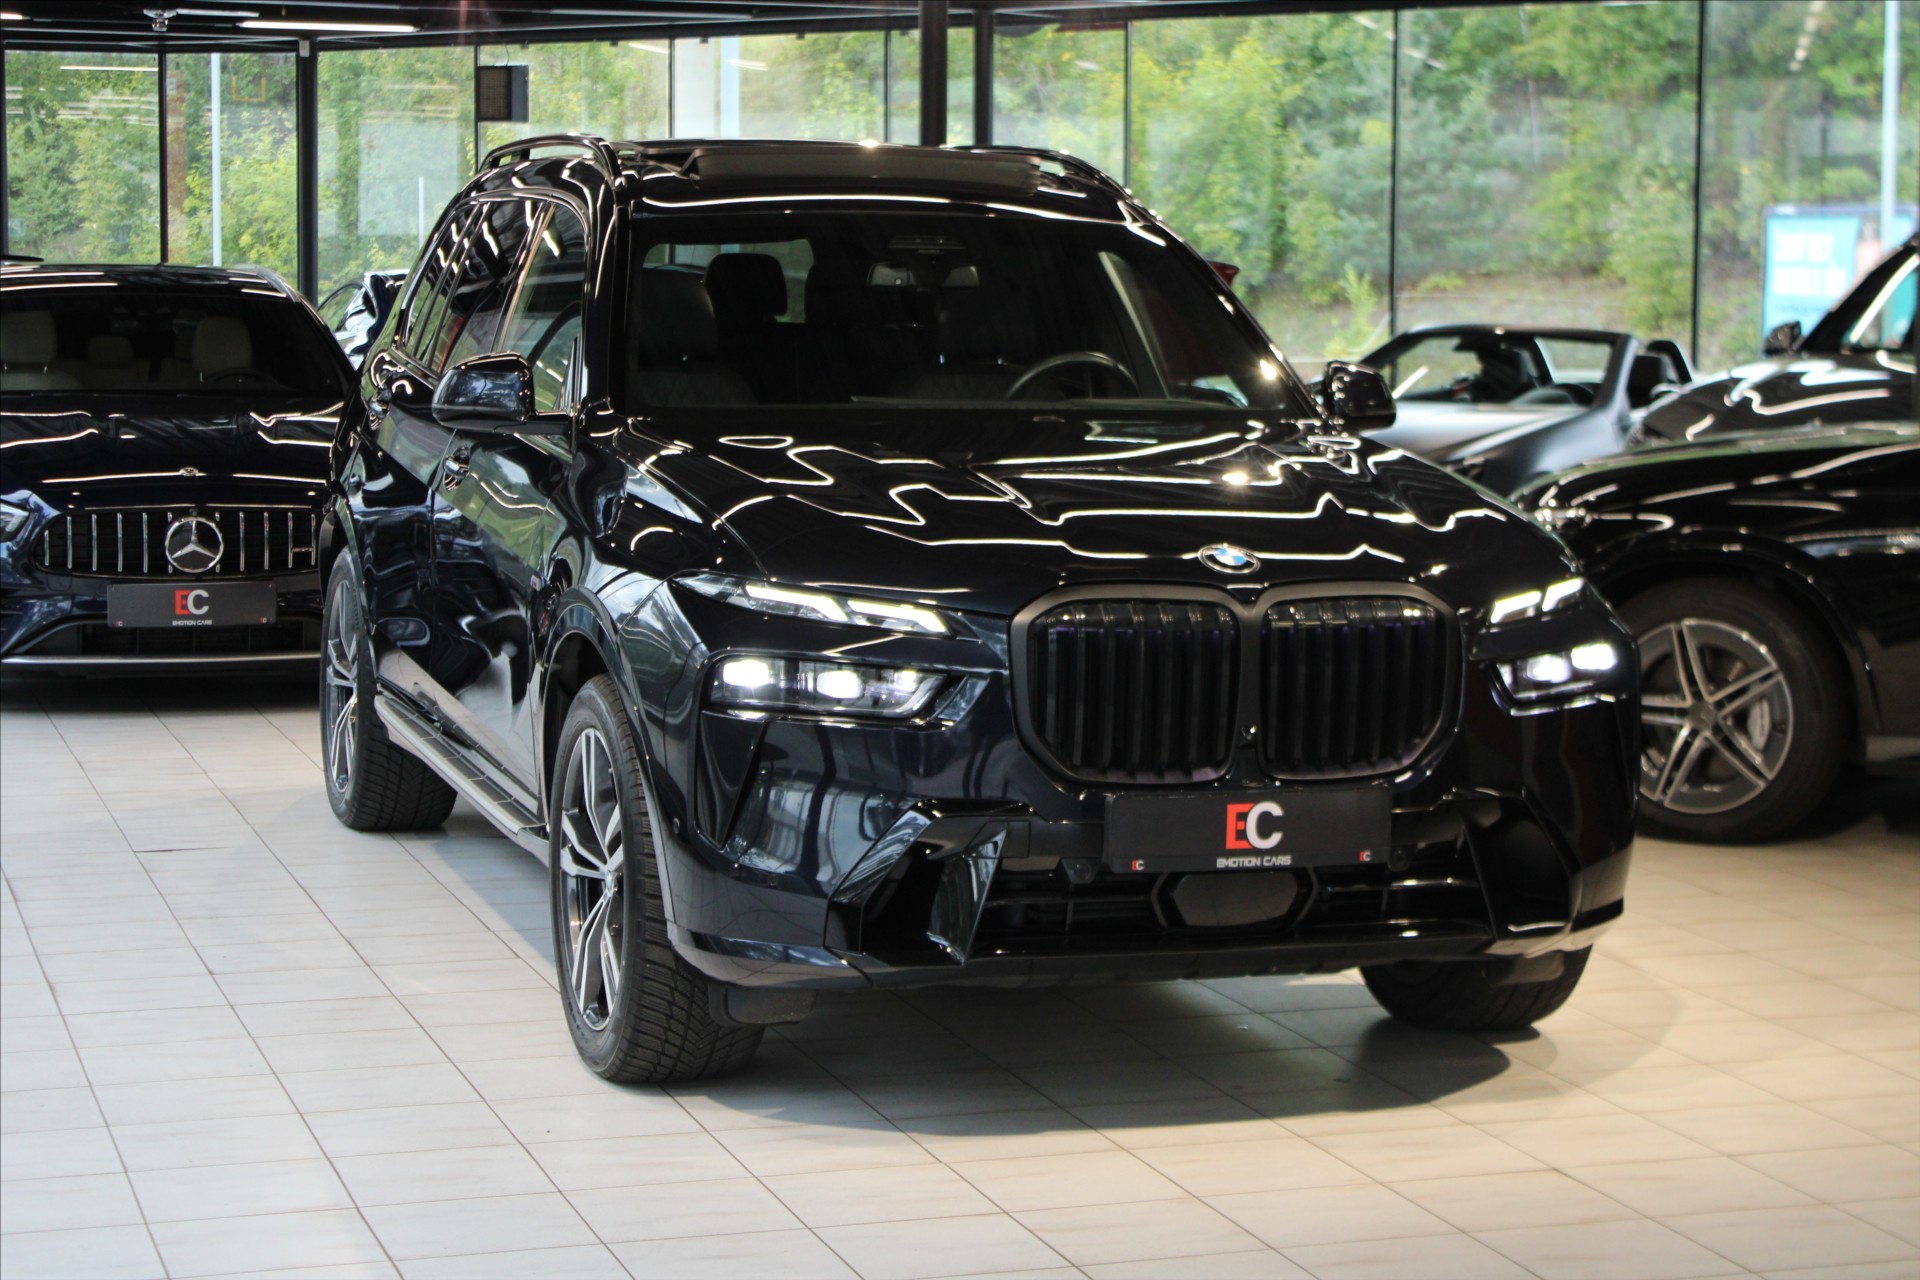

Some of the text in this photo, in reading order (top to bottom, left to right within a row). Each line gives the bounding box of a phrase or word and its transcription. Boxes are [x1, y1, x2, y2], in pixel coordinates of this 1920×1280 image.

[175, 589, 209, 615] EC
[1226, 801, 1283, 849] EC
[1217, 855, 1291, 868] EMOTION CARS
